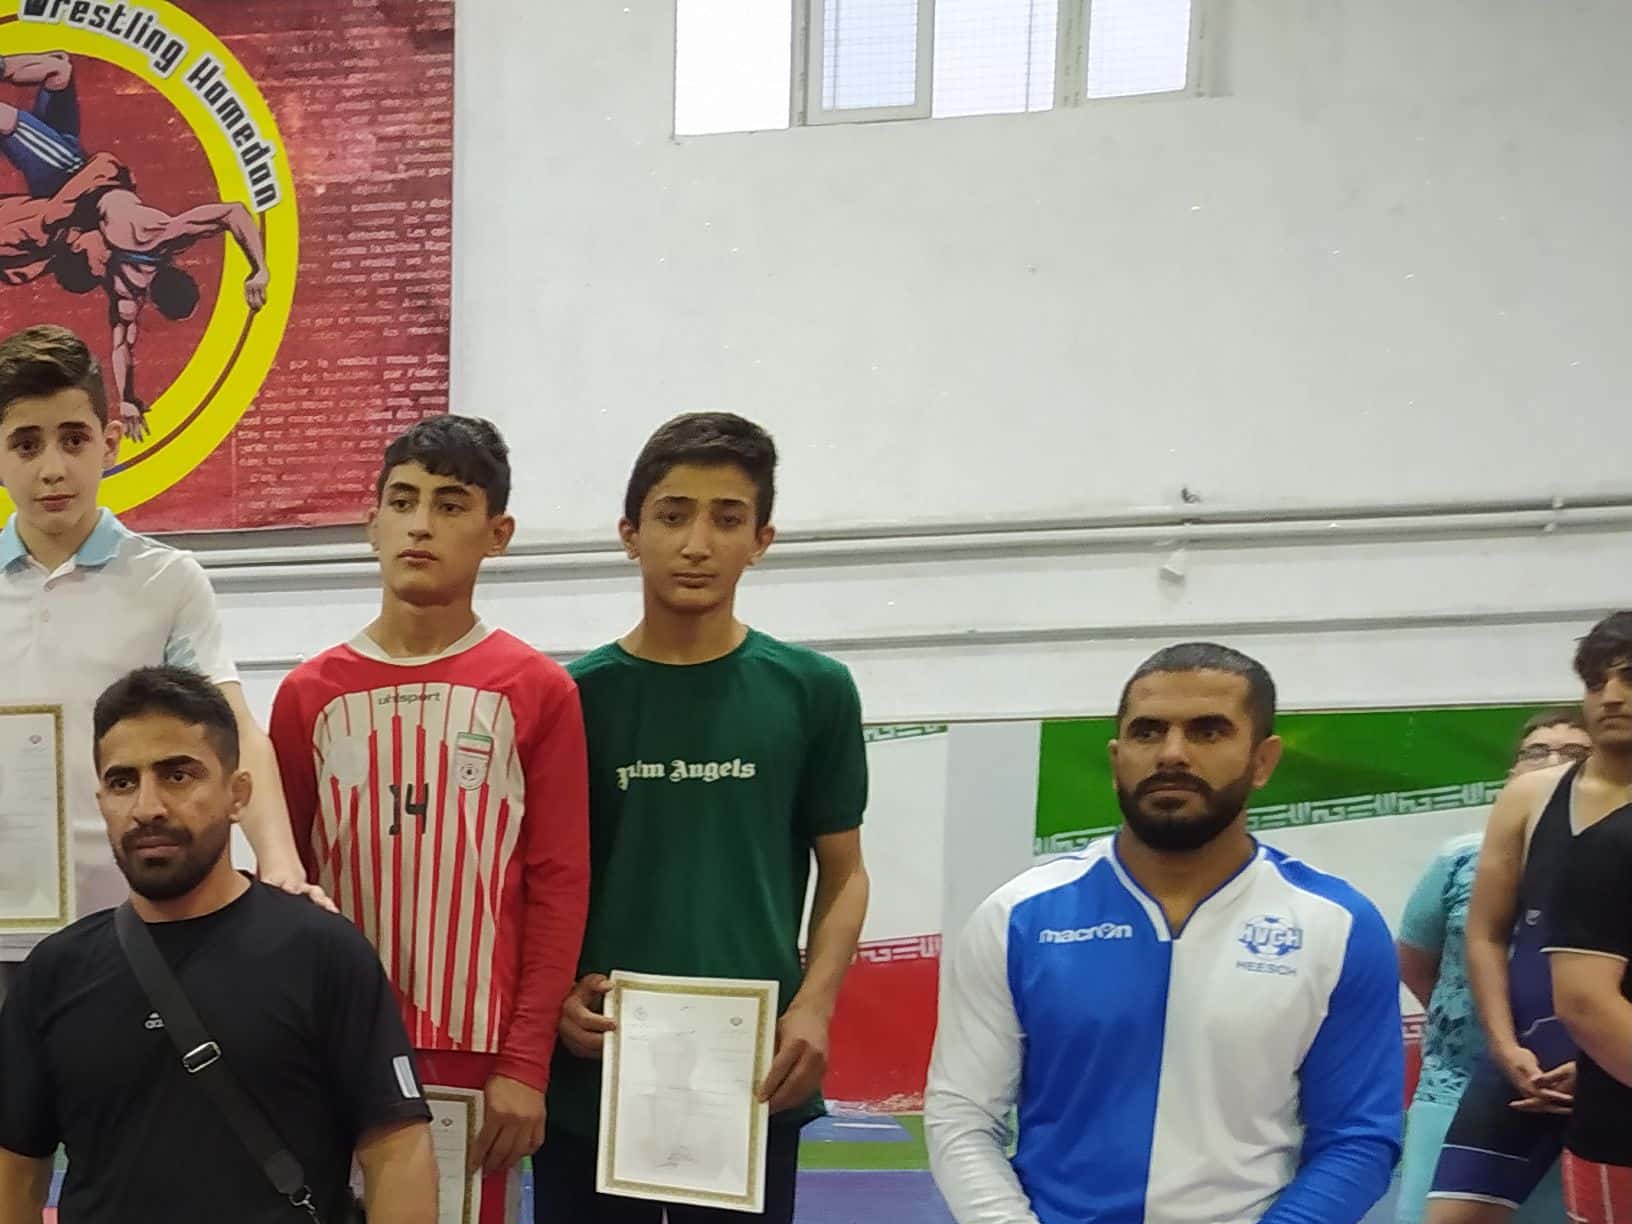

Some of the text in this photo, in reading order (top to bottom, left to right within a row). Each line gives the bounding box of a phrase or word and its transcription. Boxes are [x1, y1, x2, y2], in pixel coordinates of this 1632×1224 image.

[669, 758, 756, 782] Angels
[389, 782, 429, 836] 14
[1039, 922, 1133, 944] macron
